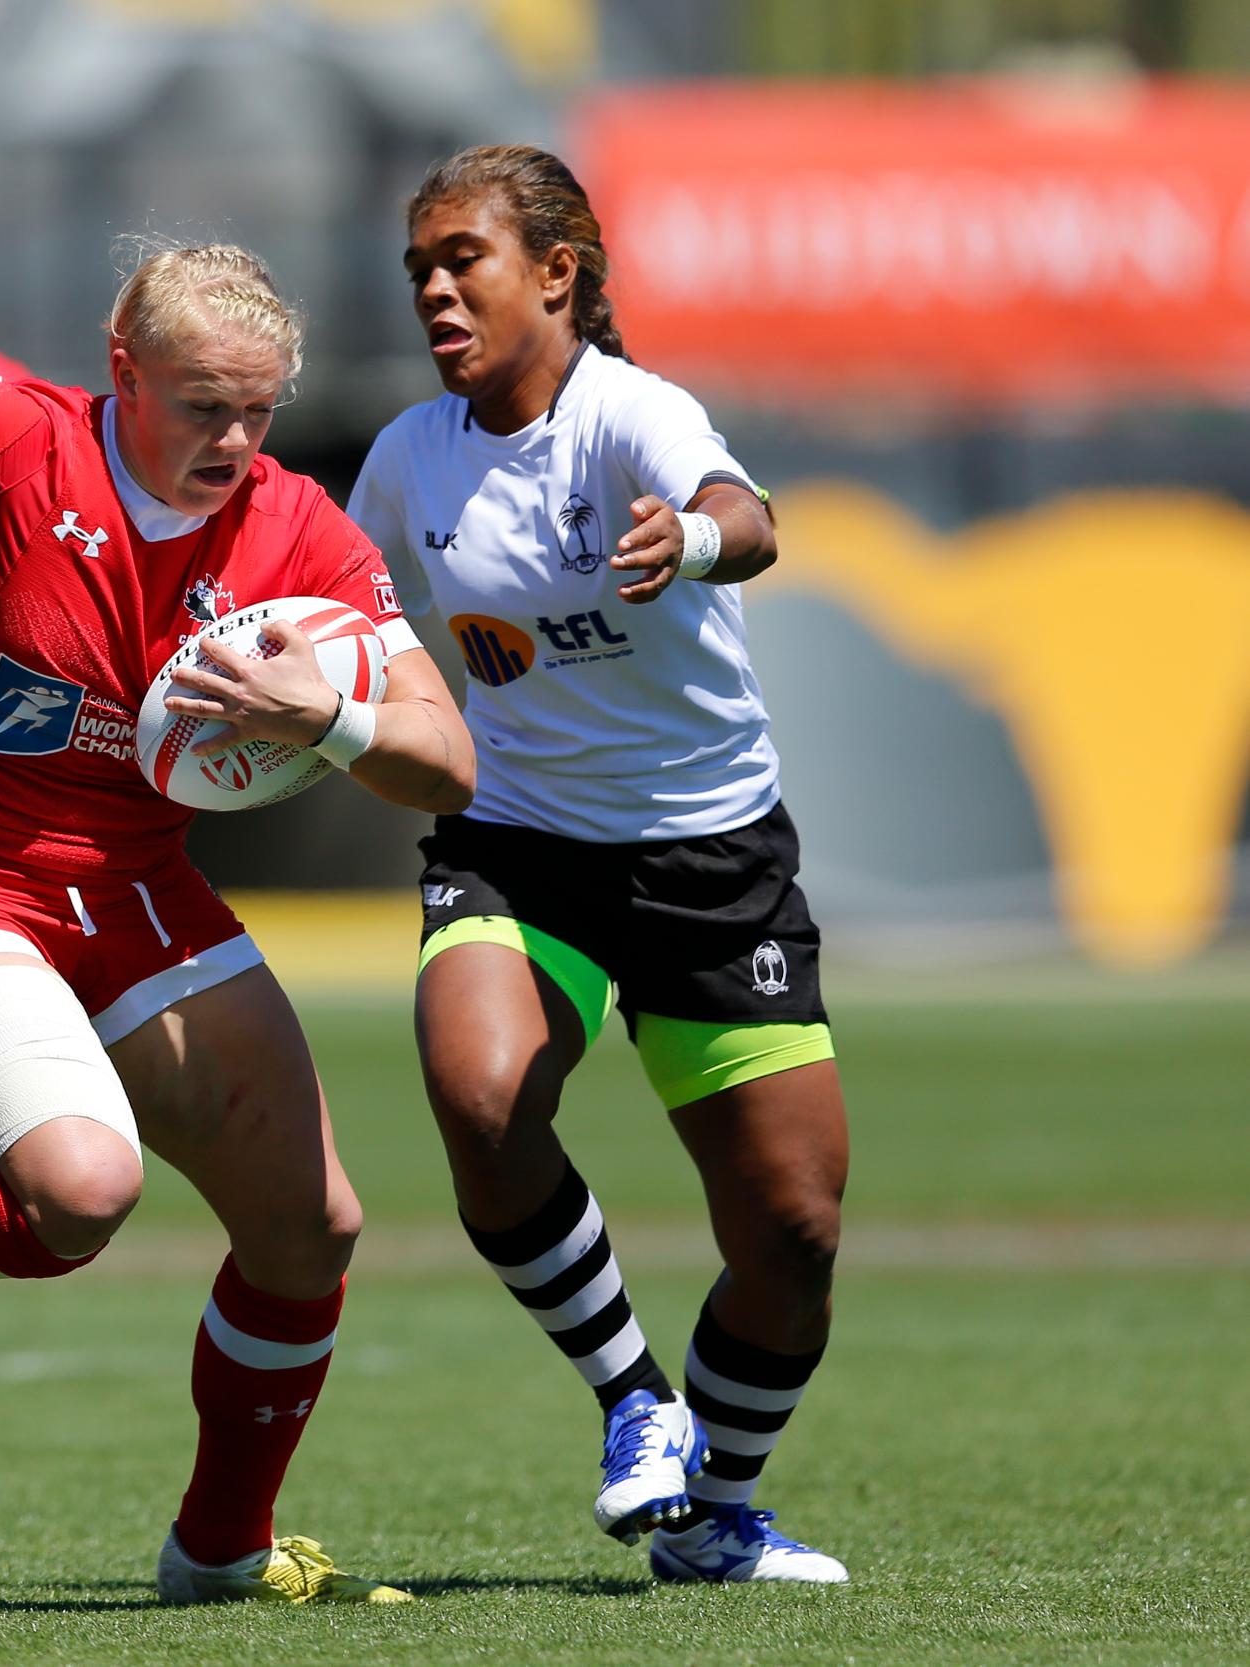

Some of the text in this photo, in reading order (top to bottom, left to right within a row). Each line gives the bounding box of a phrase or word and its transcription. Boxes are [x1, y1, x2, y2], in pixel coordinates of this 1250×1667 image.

[79, 715, 137, 742] WOM
[73, 736, 139, 761] CHAM
[261, 747, 300, 775] SEVENS
